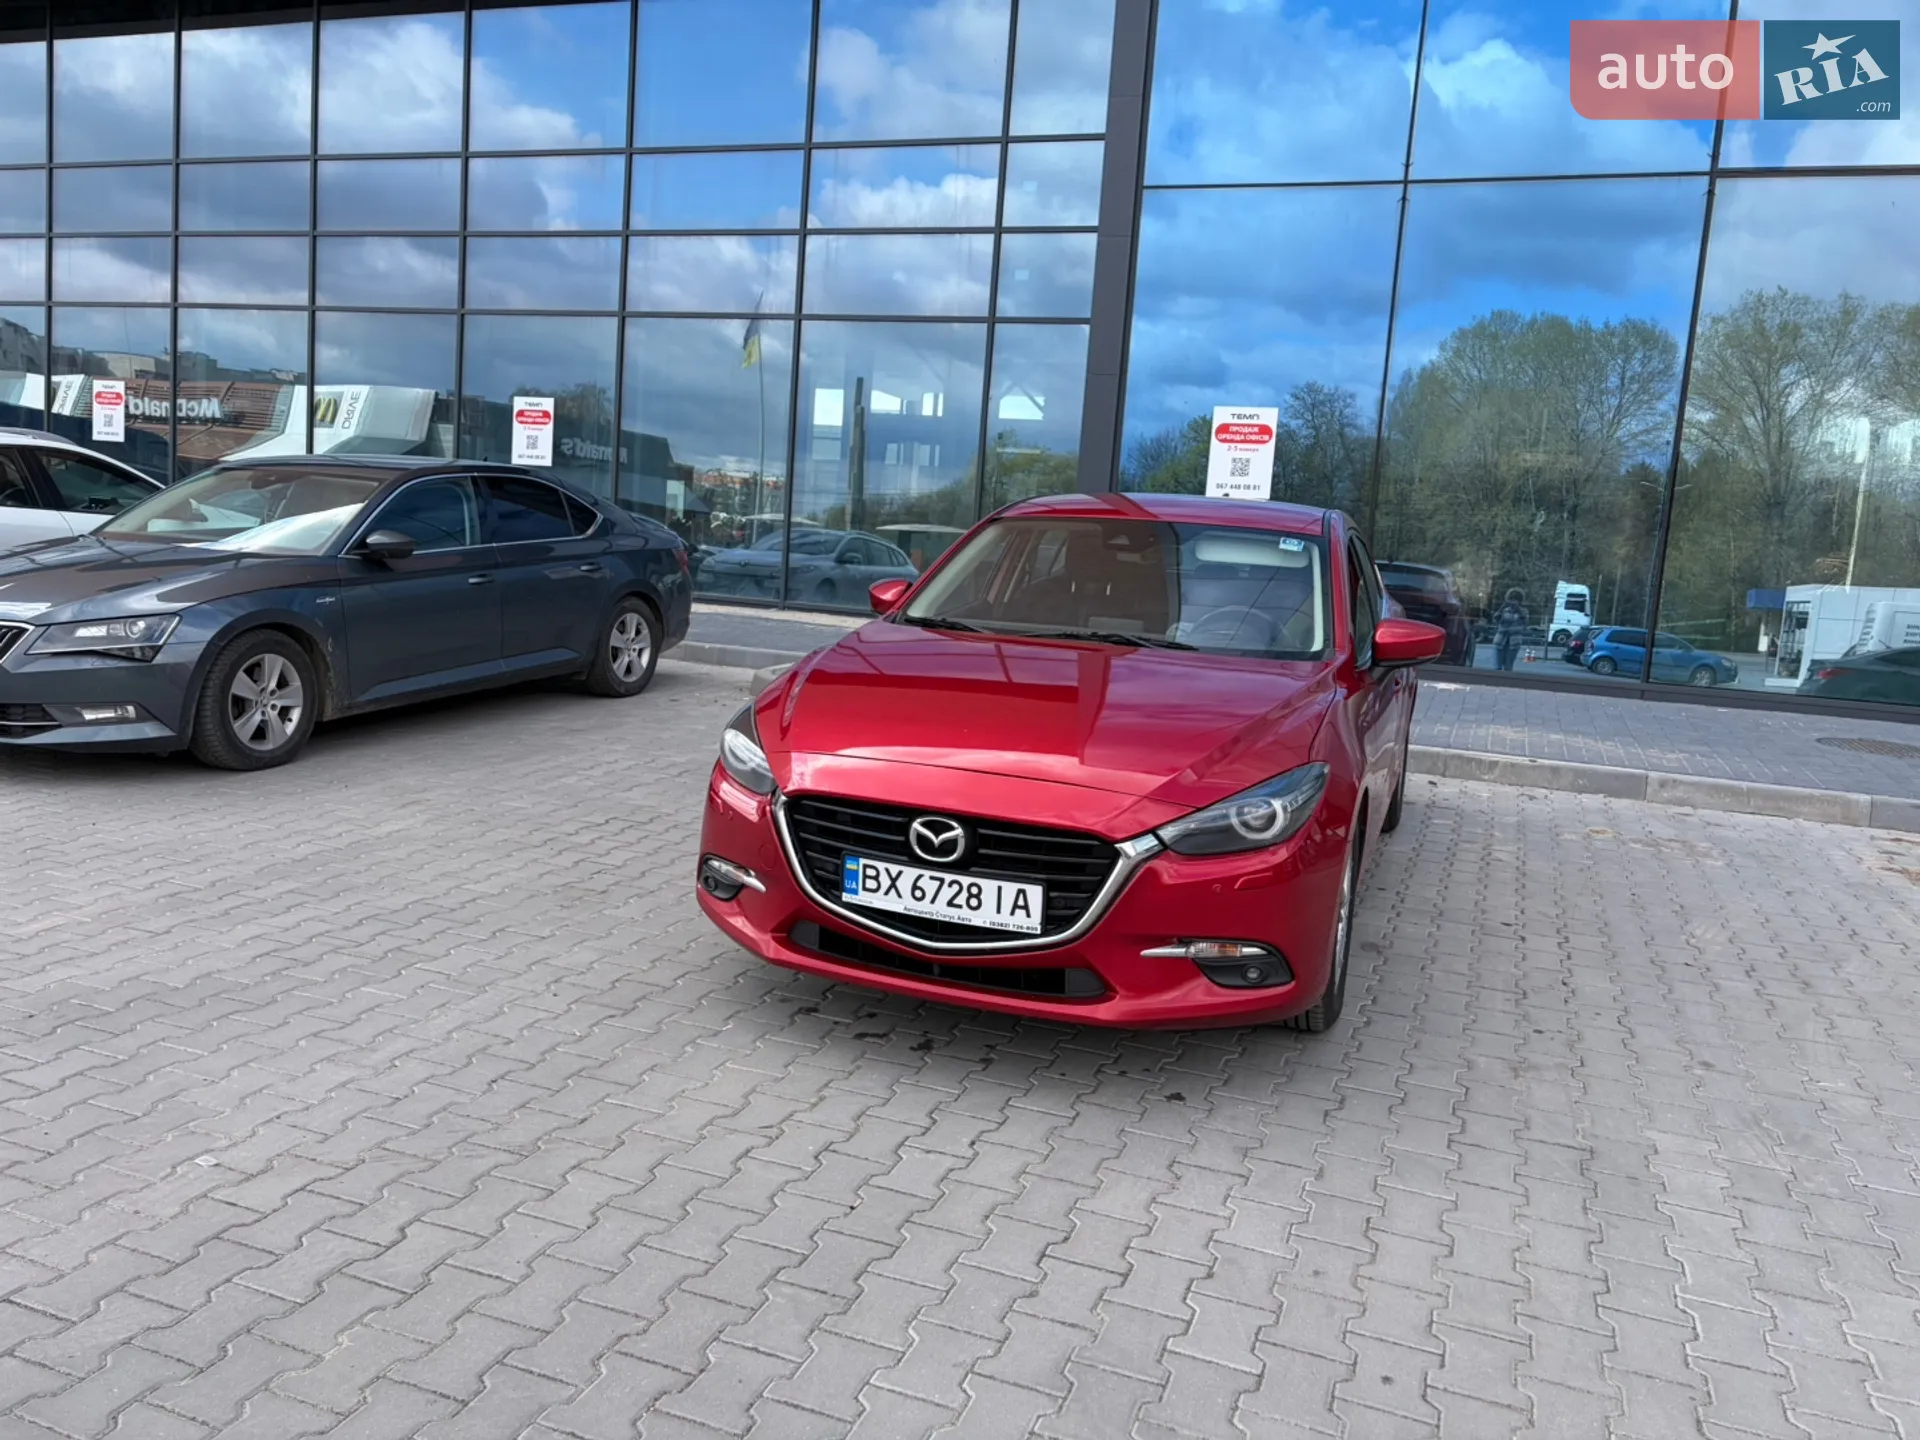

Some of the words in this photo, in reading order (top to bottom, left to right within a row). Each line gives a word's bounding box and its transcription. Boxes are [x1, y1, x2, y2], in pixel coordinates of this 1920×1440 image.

[845, 879, 858, 889] UA
[861, 863, 904, 899] BX
[910, 873, 983, 911] 6728
[996, 885, 1032, 919] IA
